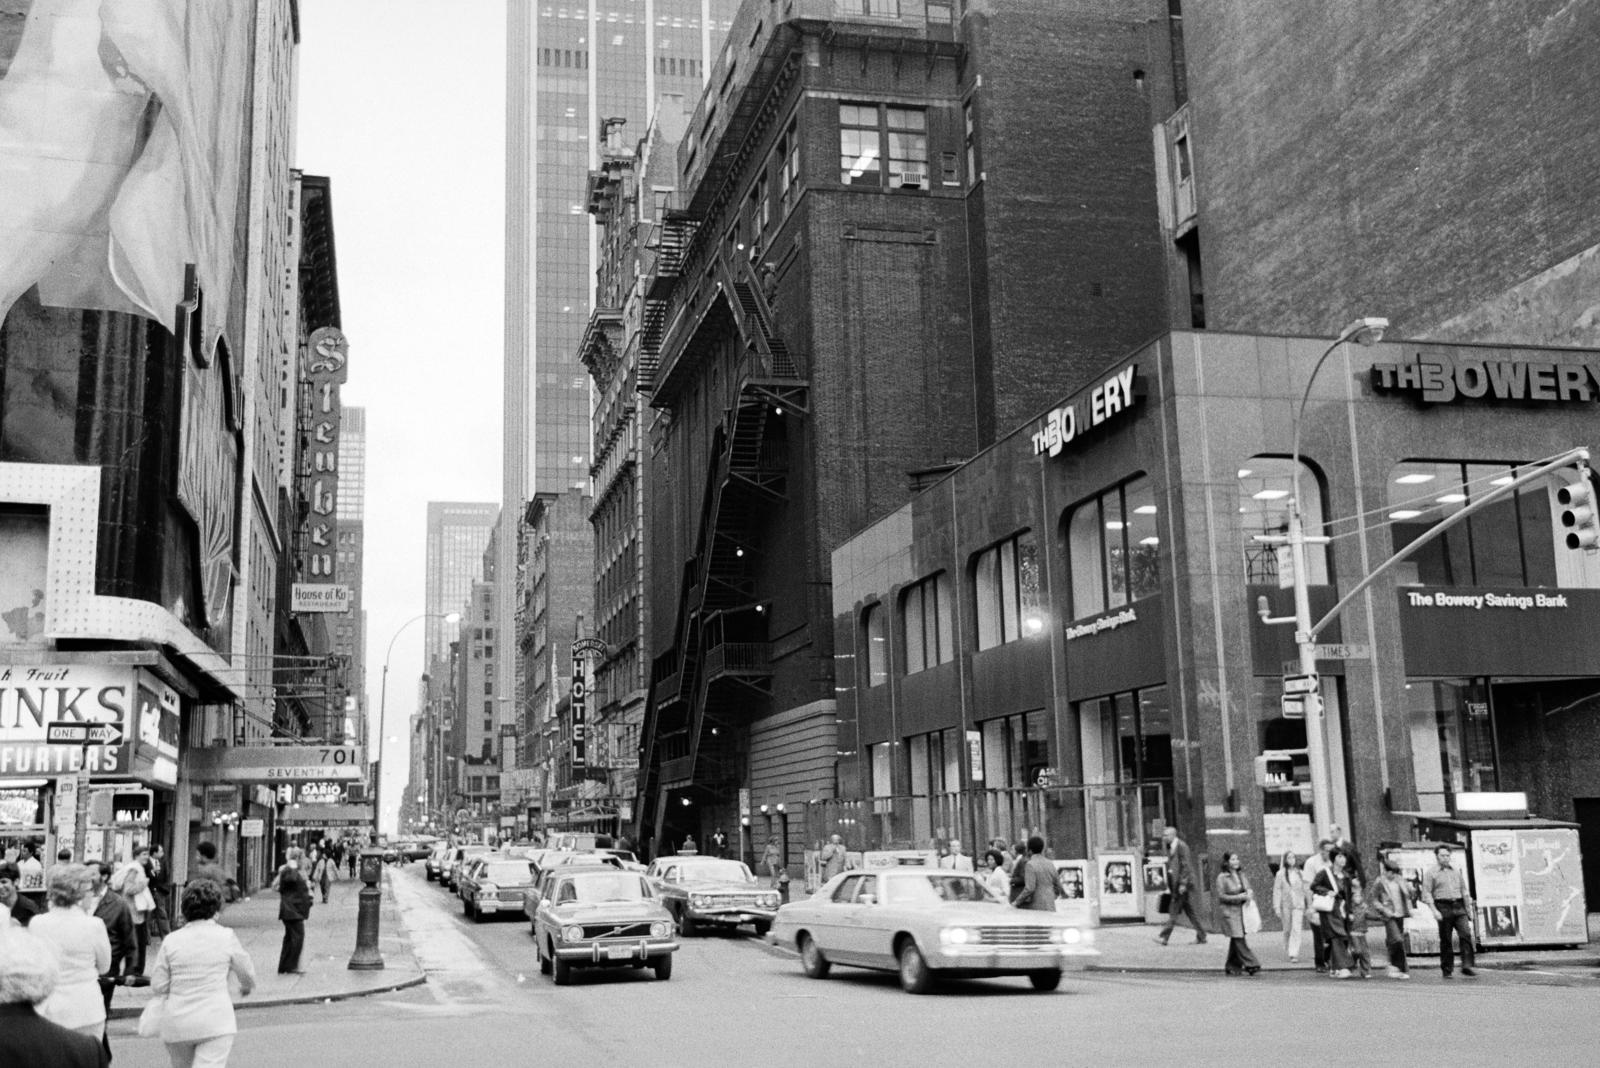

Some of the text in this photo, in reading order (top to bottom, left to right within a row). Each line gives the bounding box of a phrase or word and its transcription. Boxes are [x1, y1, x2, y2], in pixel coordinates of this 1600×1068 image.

[1048, 364, 1136, 458] BOWERY
[295, 586, 323, 601] House
[325, 588, 334, 600] of
[1407, 592, 1567, 610] The Bowery Savings Bank
[1322, 645, 1351, 658] TIMES
[27, 668, 70, 681] Fruit
[573, 659, 585, 763] HOTEL
[53, 729, 113, 738] ONE WAY
[319, 749, 356, 765] 701
[267, 768, 325, 777] SEVENTH
[301, 785, 341, 795] DARIO
[115, 809, 150, 822] WALK
